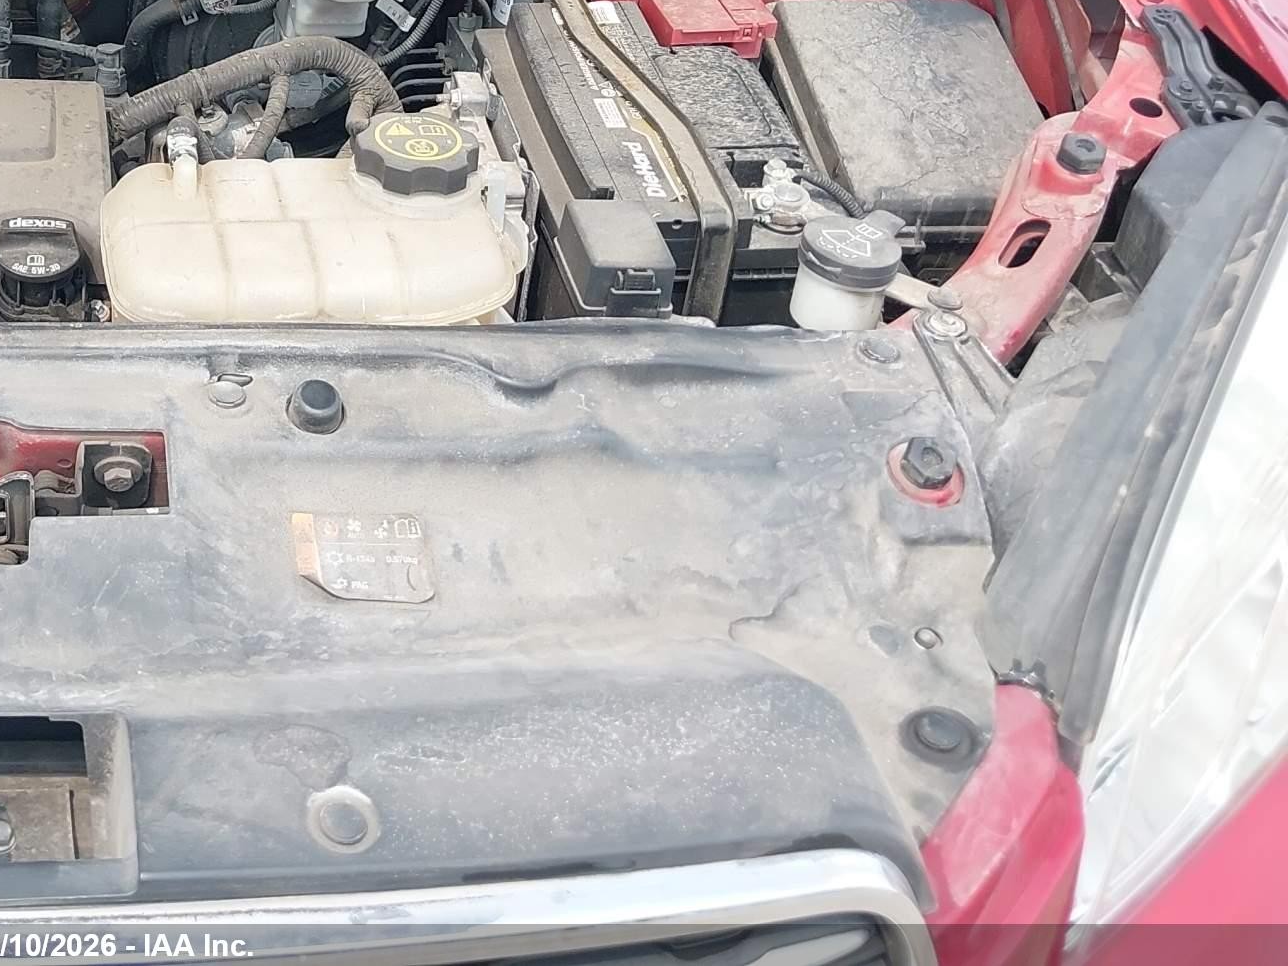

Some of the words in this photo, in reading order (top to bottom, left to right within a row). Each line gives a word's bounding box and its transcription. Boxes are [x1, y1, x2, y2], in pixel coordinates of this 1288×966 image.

[621, 140, 667, 198] DieHard
[8, 217, 68, 229] dexos
[12, 262, 29, 273] SAE
[31, 262, 61, 275] 5W-30
